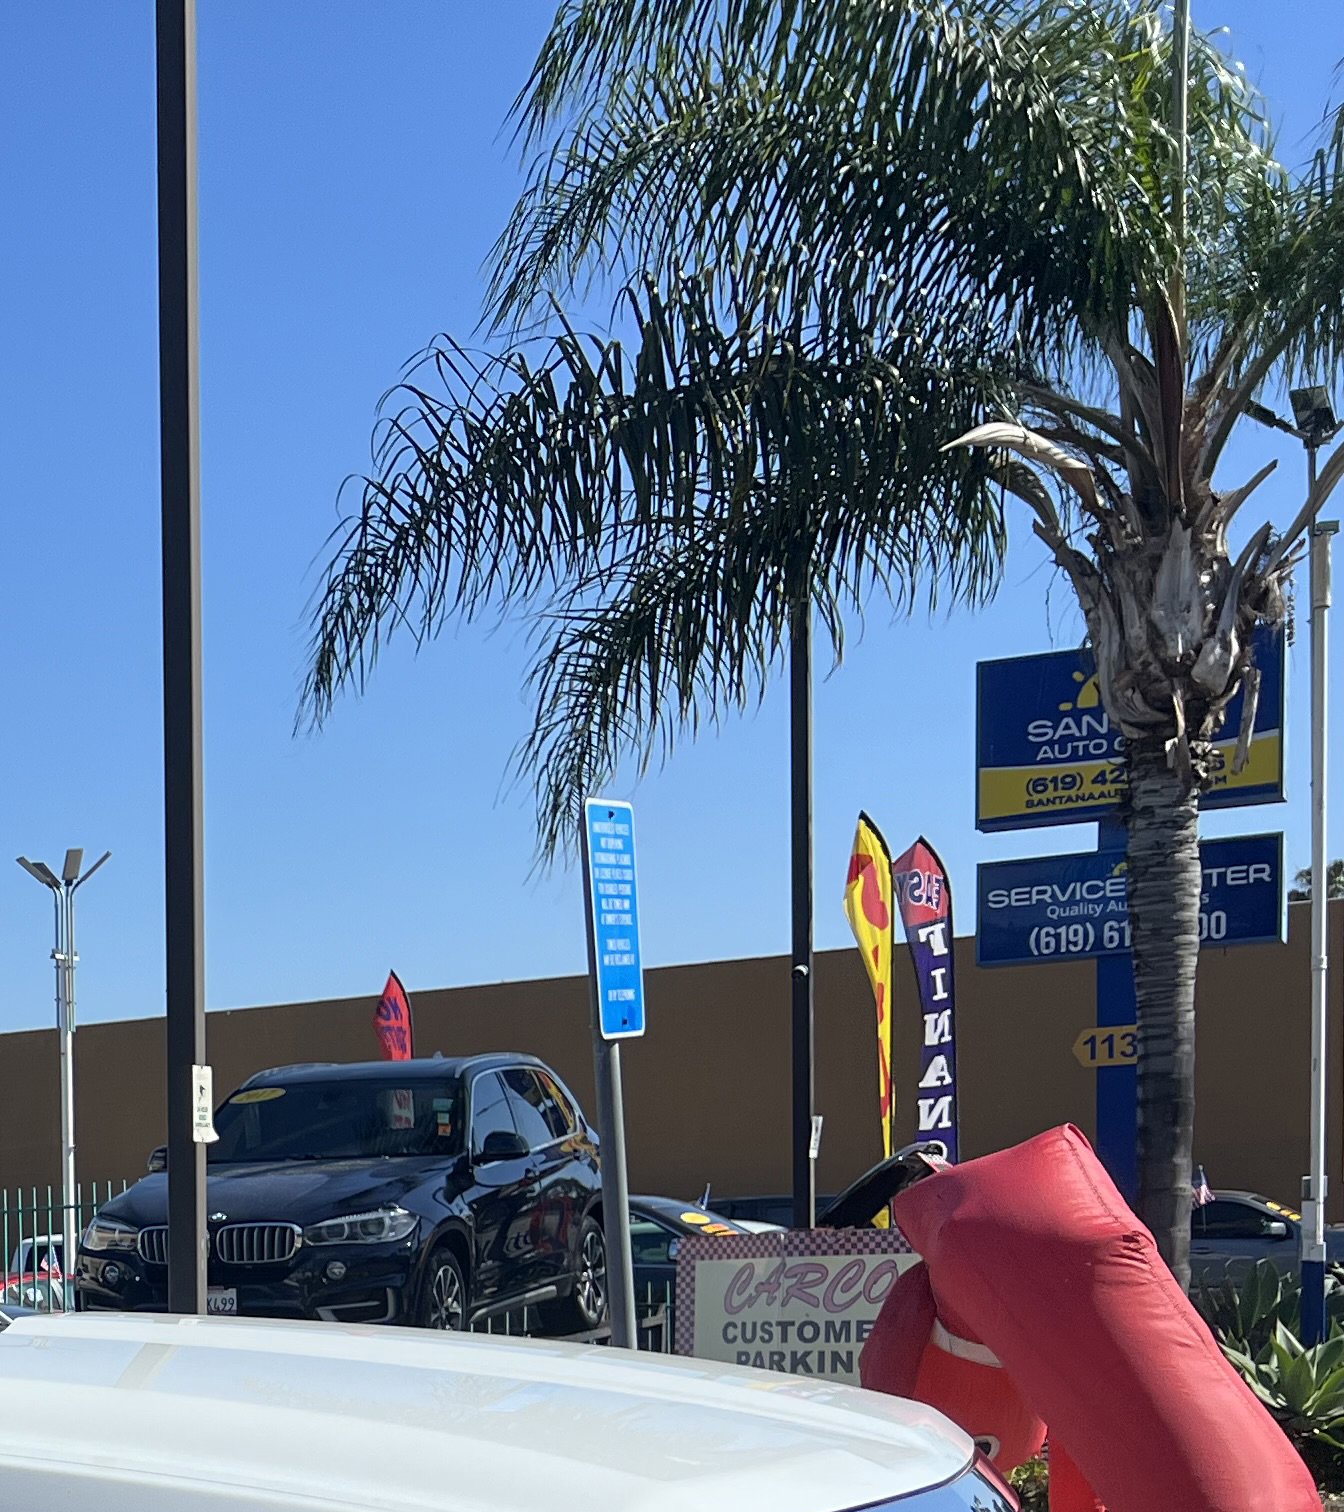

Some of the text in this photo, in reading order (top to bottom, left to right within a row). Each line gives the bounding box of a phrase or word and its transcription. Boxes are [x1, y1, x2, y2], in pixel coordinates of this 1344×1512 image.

[1036, 738, 1108, 761] AUTO
[1026, 772, 1084, 797] (619)
[987, 863, 1272, 909] SERVICE TER
[1046, 902, 1103, 920] Quality
[1029, 921, 1095, 955] (619)
[1082, 1032, 1138, 1061] 113
[724, 1258, 899, 1315] CARCO
[722, 1319, 877, 1344] CUSTOME
[736, 1350, 853, 1374] PARKIN
